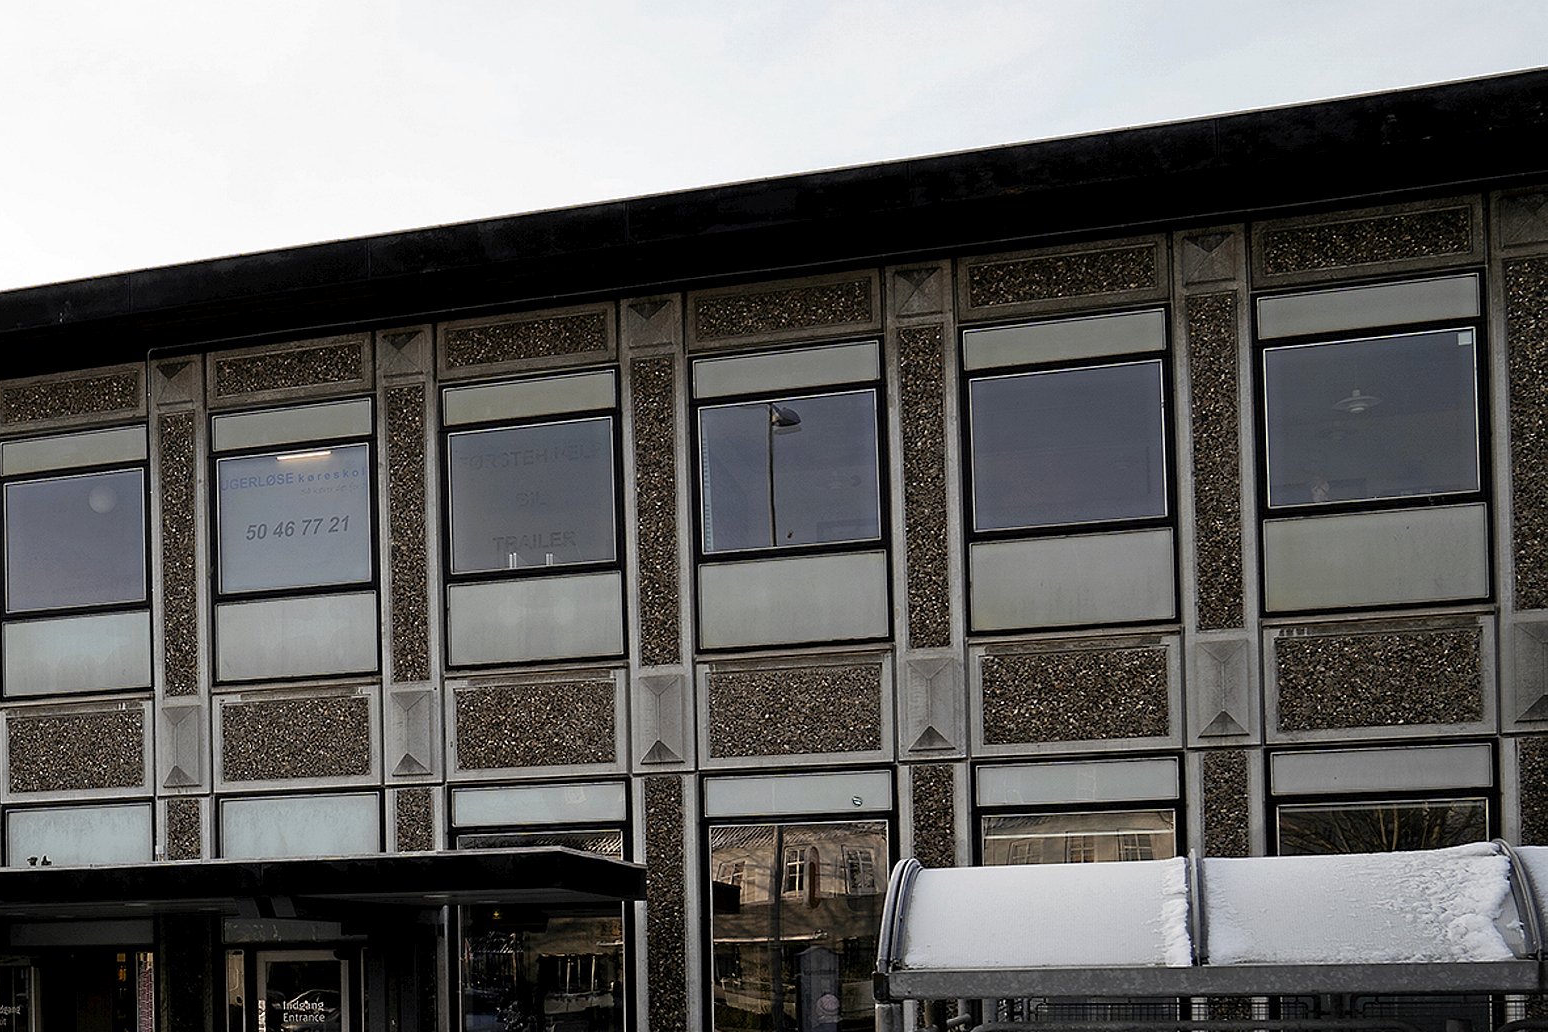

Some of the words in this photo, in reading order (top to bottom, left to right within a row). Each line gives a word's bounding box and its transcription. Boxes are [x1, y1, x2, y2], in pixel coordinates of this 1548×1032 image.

[246, 523, 267, 541] 50
[272, 521, 296, 538] 46
[301, 518, 324, 536] 77
[328, 515, 350, 533] 21
[492, 530, 577, 550] TRAILER
[283, 1000, 325, 1012] Indgang
[283, 1012, 326, 1023] Entrance
